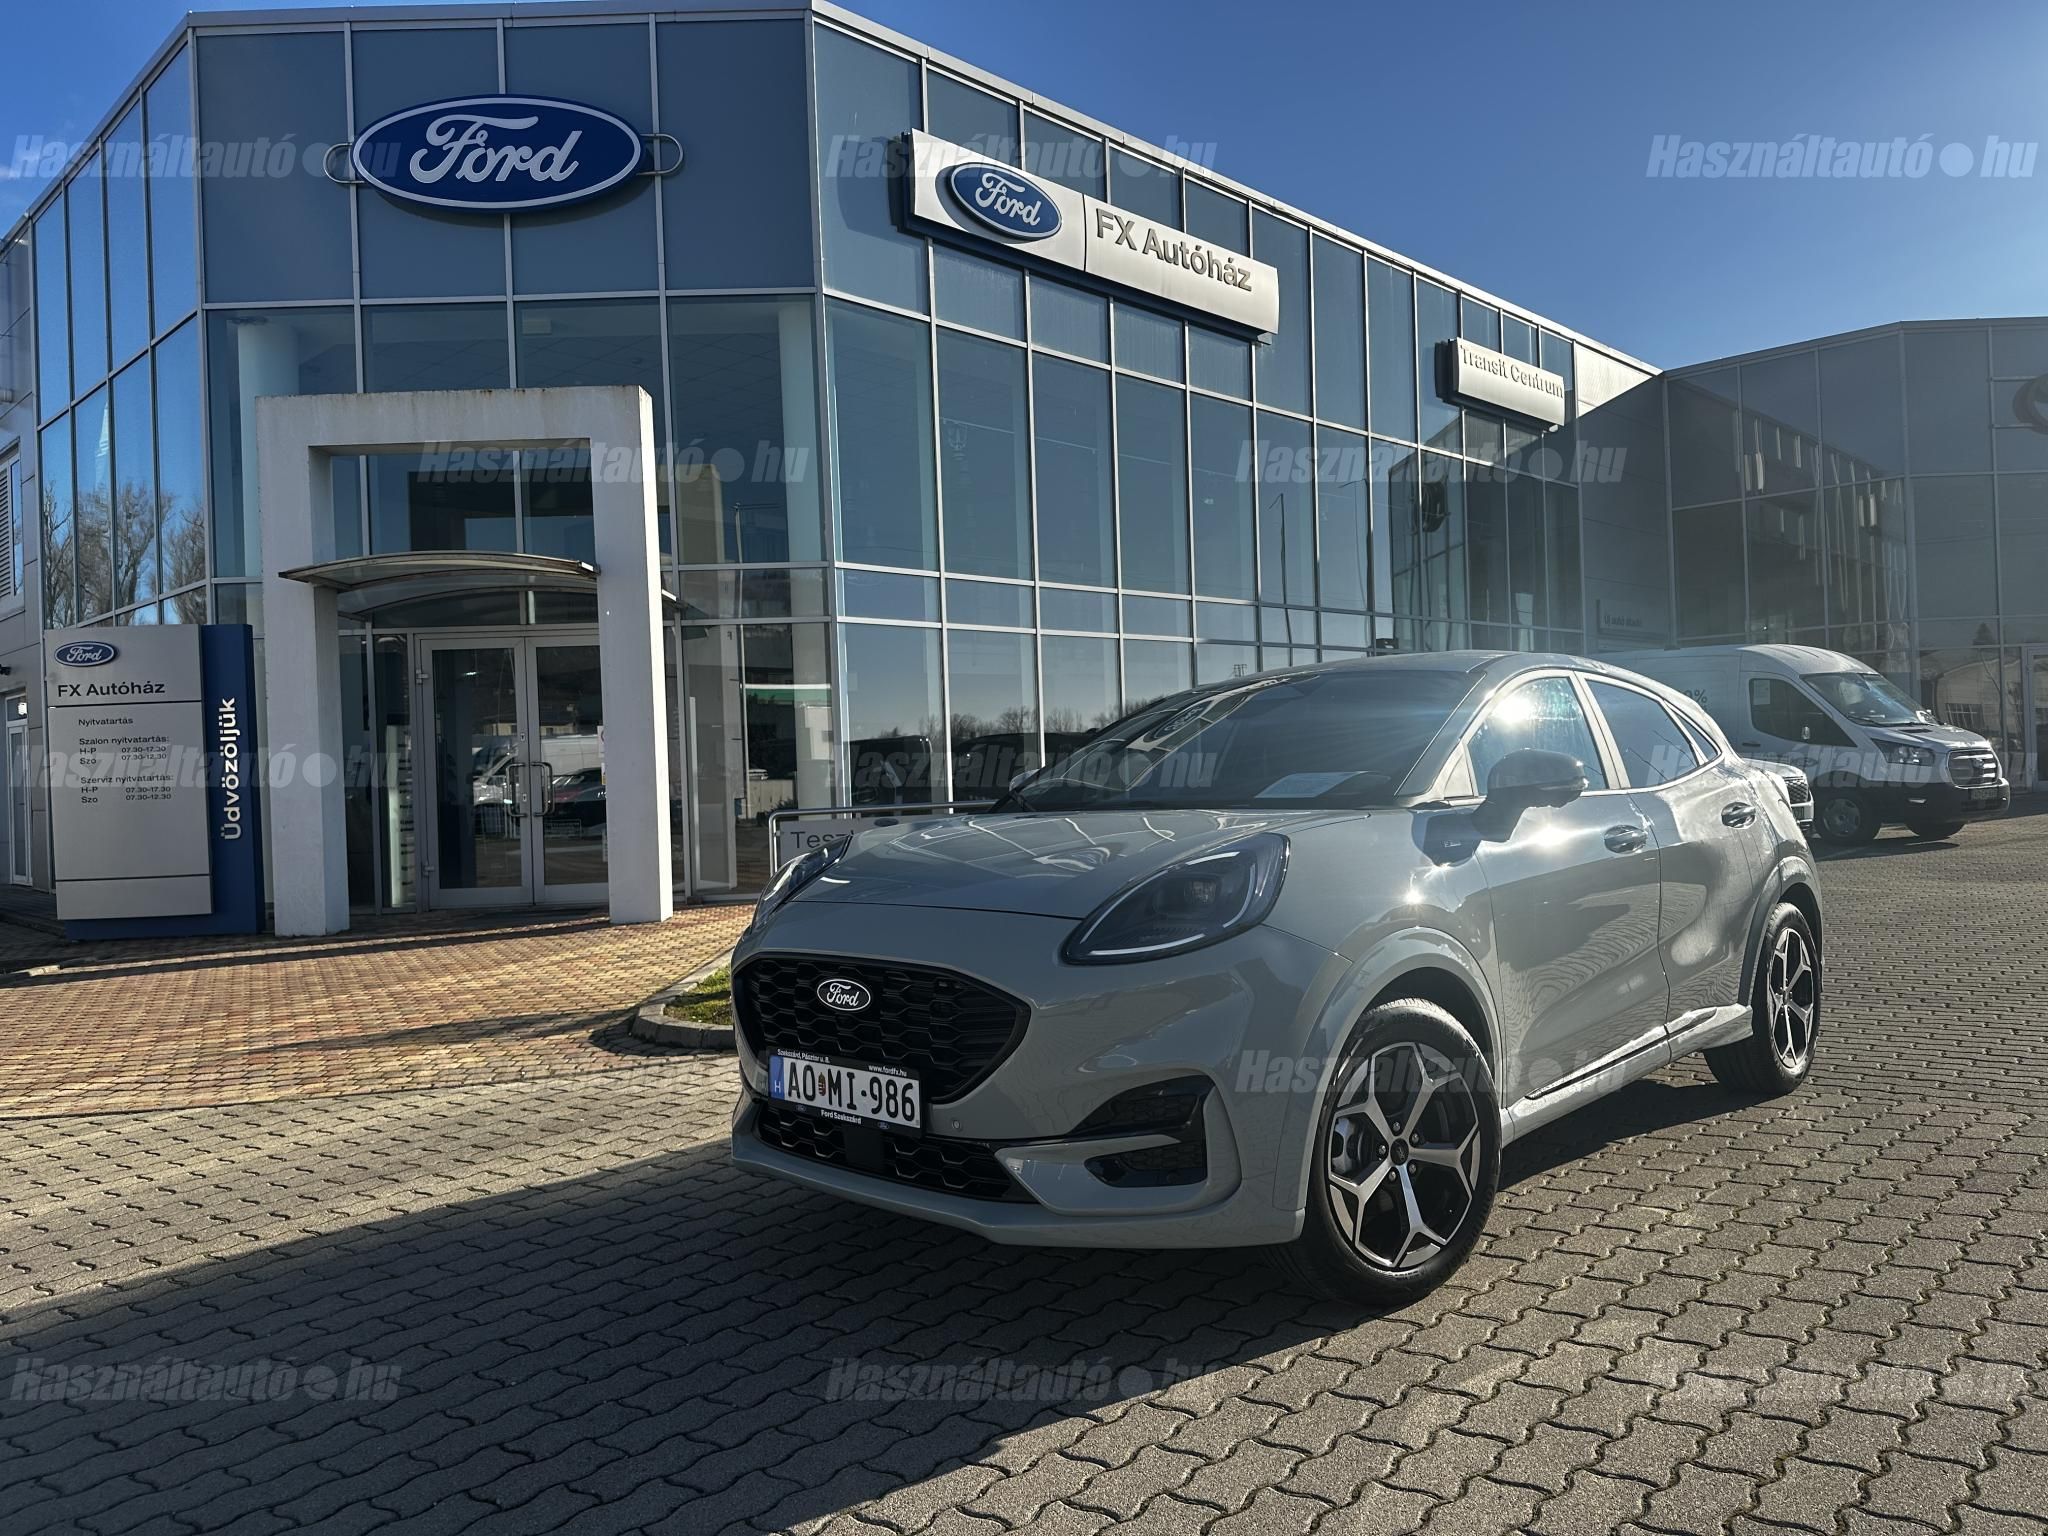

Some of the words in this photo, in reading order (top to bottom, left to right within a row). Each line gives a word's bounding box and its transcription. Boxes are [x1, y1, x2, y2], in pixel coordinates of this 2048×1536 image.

[409, 113, 583, 184] Ford
[974, 171, 1043, 228] Ford
[1096, 207, 1138, 252] FX
[1142, 226, 1254, 292] Autóház
[1460, 344, 1508, 379] Transit
[1510, 363, 1564, 399] Centrum
[66, 645, 102, 662] Ford
[57, 683, 82, 698] FX
[86, 680, 166, 697] Autóház
[78, 716, 134, 727] Nyitvatartás
[79, 747, 97, 755] H-P
[79, 757, 97, 765] Szo
[219, 697, 242, 841] Üdvözöljük
[80, 776, 113, 784] Szerviz
[80, 786, 99, 794] H-P
[80, 796, 99, 804] Szo
[826, 982, 860, 1006] Ford
[774, 1080, 782, 1093] H
[821, 1109, 834, 1119] Ford
